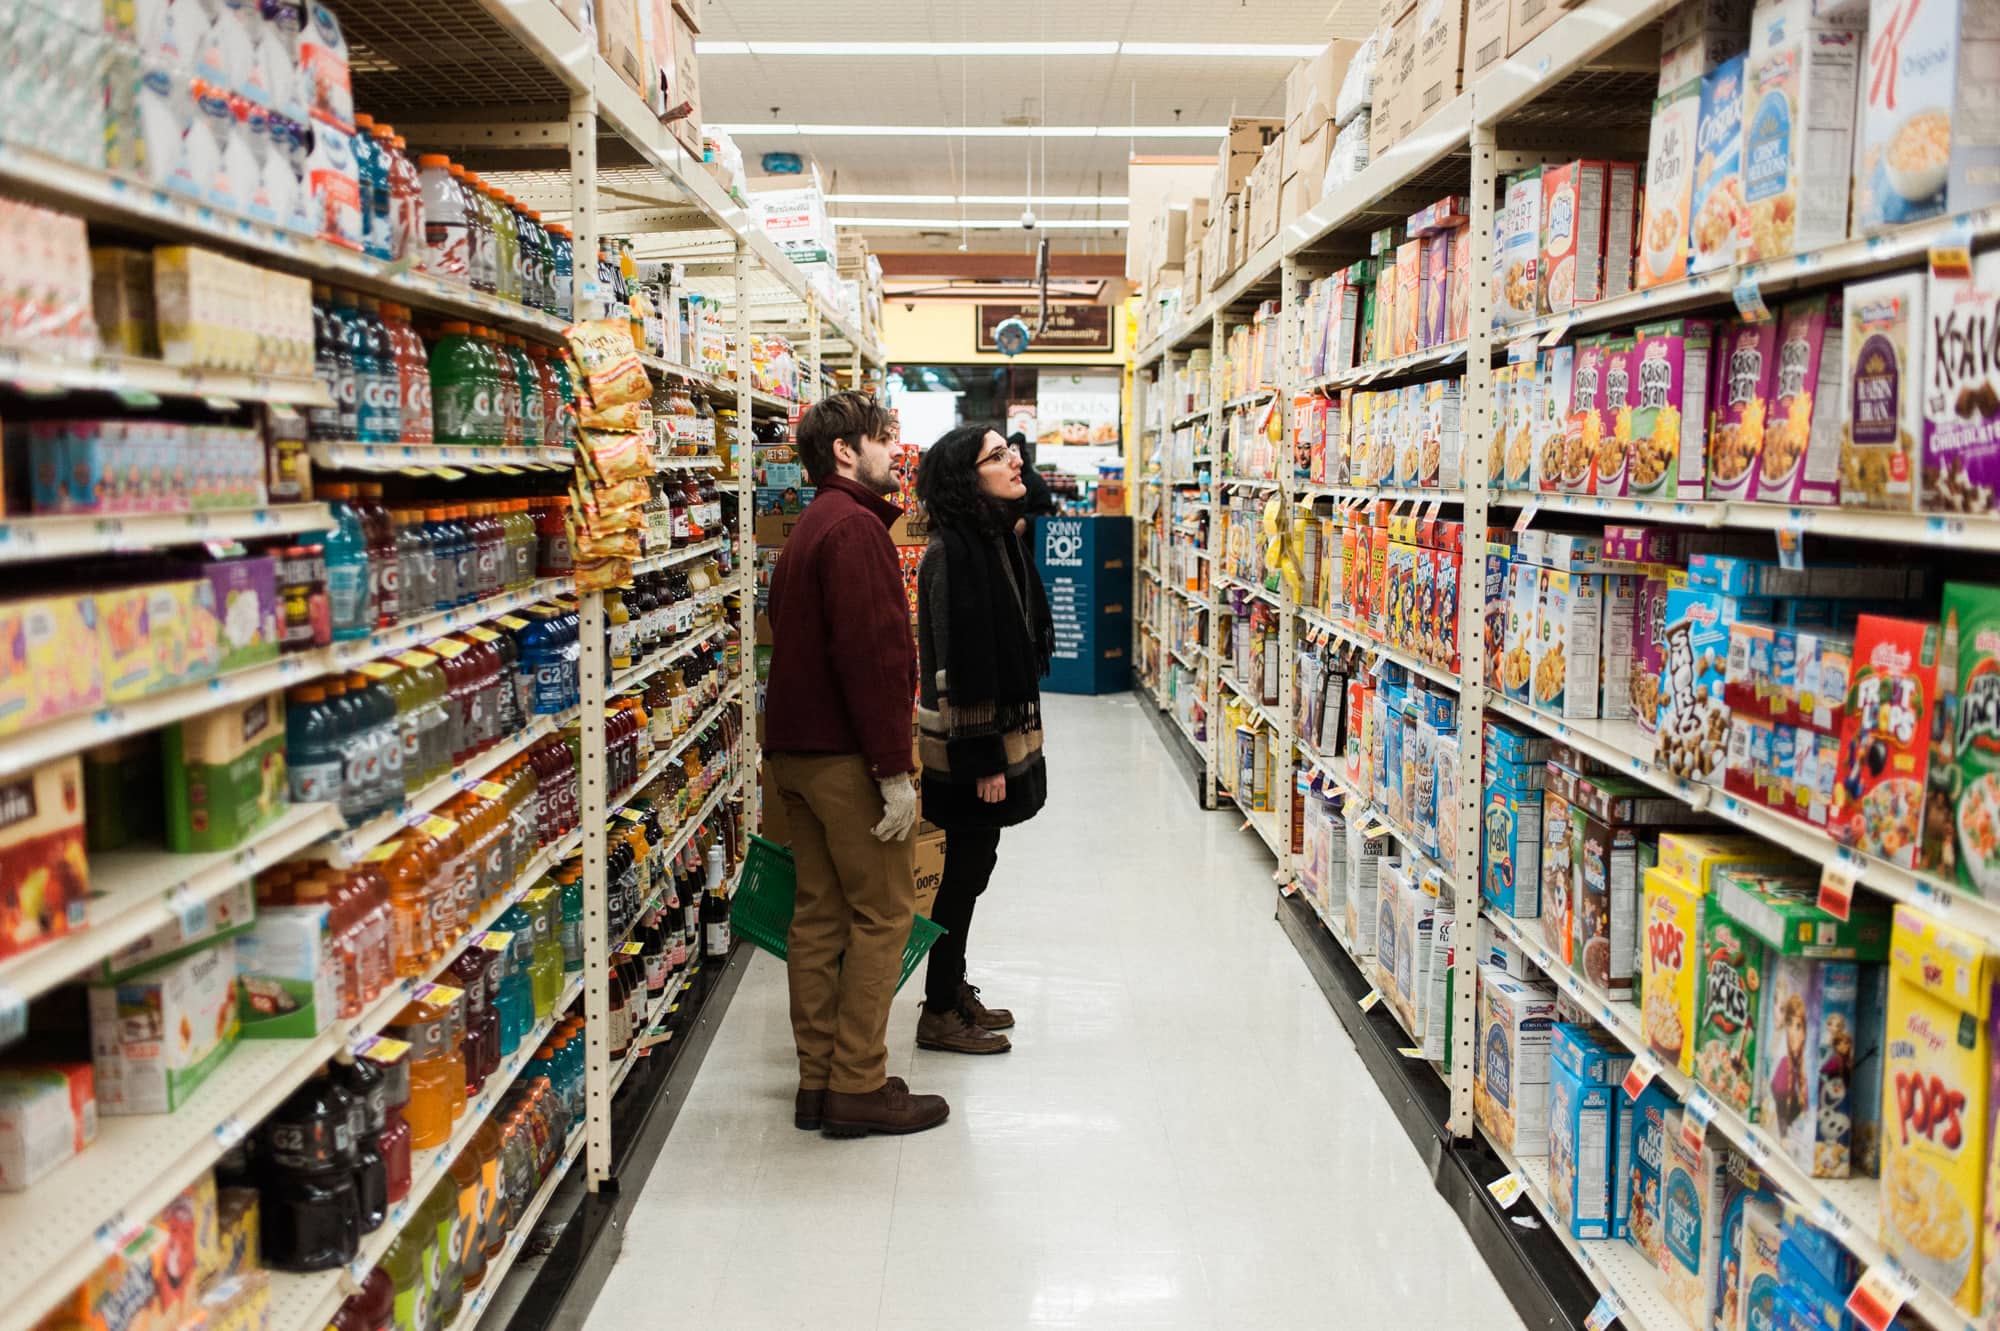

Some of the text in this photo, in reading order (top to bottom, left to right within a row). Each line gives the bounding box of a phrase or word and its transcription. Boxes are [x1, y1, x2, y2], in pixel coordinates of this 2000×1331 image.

[1902, 43, 1950, 77] Original
[1654, 157, 1680, 185] Bran
[1507, 200, 1533, 217] SMART
[1507, 215, 1532, 232] START
[523, 258, 533, 281] G
[1056, 315, 1075, 326] the
[1039, 328, 1101, 341] Community
[1576, 370, 1598, 392] Raisin
[1640, 363, 1670, 389] Raisin
[364, 382, 380, 408] G
[380, 383, 398, 408] G
[475, 391, 489, 416] G
[1575, 391, 1593, 412] Bran
[1641, 385, 1666, 408] Bran
[1046, 519, 1082, 536] SKINNY
[554, 537, 566, 550] G
[1046, 535, 1082, 559] POP
[517, 547, 528, 563] G
[1046, 558, 1082, 566] POPCORN
[381, 566, 398, 591] G
[1577, 585, 1595, 598] Life
[538, 667, 562, 685] G2
[1670, 628, 1703, 735] SMORZ
[402, 727, 419, 754] G
[383, 741, 403, 771] G
[559, 788, 569, 803] G
[538, 800, 547, 815] G
[1363, 842, 1383, 850] CORN
[490, 848, 501, 872] G
[916, 873, 940, 890] OOPS
[609, 897, 619, 912] G
[534, 916, 546, 932] G
[1648, 921, 1684, 974] POPS
[490, 964, 499, 980] G
[1713, 960, 1738, 986] APPLE
[470, 983, 480, 1000] G
[426, 1023, 441, 1043] G
[1906, 1013, 1947, 1051] Kellogg's
[1890, 1040, 1915, 1060] CORN
[1489, 1050, 1506, 1076] CORN
[1487, 1068, 1508, 1092] FLAKES
[1895, 1070, 1966, 1151] POPS
[273, 1129, 303, 1149] G2
[1647, 1124, 1663, 1149] RIC
[1638, 1135, 1663, 1171] KRISP
[1729, 1149, 1748, 1169] WIN
[1668, 1198, 1697, 1236] CRISPY
[1671, 1220, 1691, 1249] RICE
